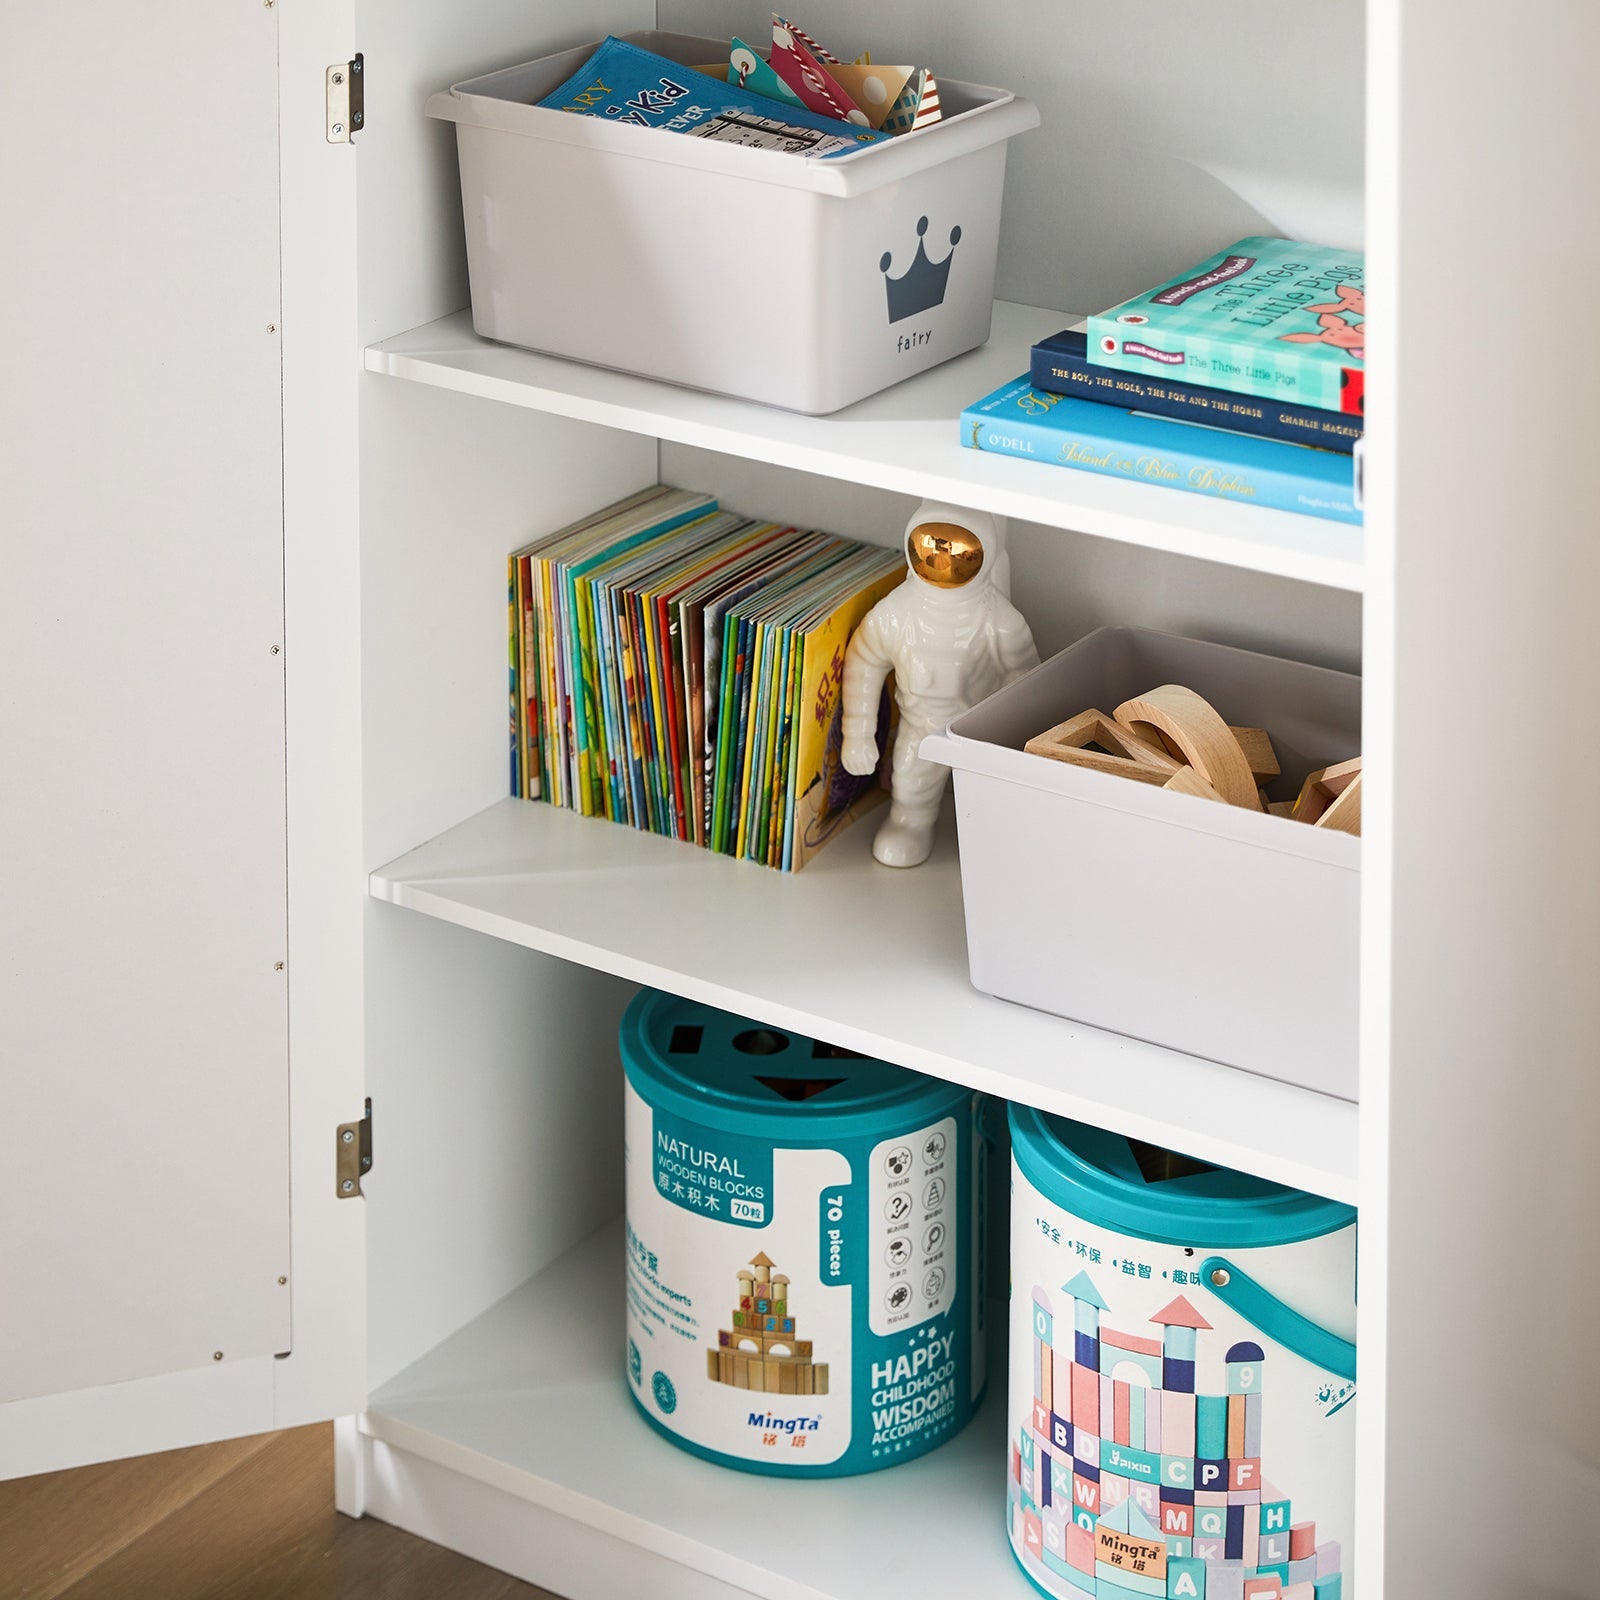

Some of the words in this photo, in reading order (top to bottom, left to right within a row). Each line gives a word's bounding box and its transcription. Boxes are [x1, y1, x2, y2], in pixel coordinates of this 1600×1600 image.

[625, 78, 690, 115] Kid
[1215, 262, 1308, 298] Three
[1231, 290, 1315, 327] Little
[1294, 265, 1363, 292] Pigs
[1212, 298, 1243, 312] The
[897, 330, 932, 353] fairy
[1188, 356, 1207, 369] The
[1211, 359, 1241, 375] Three
[1246, 366, 1271, 382] Little
[1275, 374, 1296, 386] Pigs
[1051, 368, 1069, 379] THE
[1072, 372, 1093, 386] BOY,
[1096, 377, 1113, 388] THE
[1116, 381, 1144, 396] MOLE,
[1147, 387, 1165, 398] THE
[1168, 391, 1186, 402] FOX
[1189, 396, 1208, 407] AND
[1211, 400, 1229, 412] THE
[1232, 404, 1263, 418] HORSE
[1279, 414, 1319, 429] CHARLIE
[988, 434, 1035, 453] O'DELL
[1056, 441, 1119, 468] Island
[1135, 454, 1180, 480] Blue
[1188, 465, 1256, 498] Dolphins
[657, 1130, 745, 1178] NATURAL
[657, 1153, 707, 1186] WOODEN
[709, 1176, 765, 1199] BLOCKS
[657, 1171, 720, 1212] 原木积木
[827, 1195, 843, 1222] 70
[827, 1229, 844, 1277] pieces
[1041, 1219, 1061, 1245] 安全
[1075, 1241, 1101, 1265] 环保
[1121, 1259, 1152, 1280] 益智
[1172, 1270, 1201, 1286] 趣味
[661, 1285, 692, 1307] experts
[872, 1330, 954, 1389] HAPPY
[1239, 1366, 1254, 1387] 9
[871, 1360, 955, 1407] CHILDHOOD
[872, 1378, 955, 1431] WISDOM
[747, 1412, 820, 1434] MingTa
[872, 1401, 955, 1445] ACCOMPANIED
[1034, 1404, 1046, 1429] T
[1054, 1421, 1067, 1447] B
[1079, 1435, 1095, 1459] D
[1054, 1466, 1068, 1489] X
[1075, 1480, 1096, 1507] W
[1106, 1479, 1121, 1500] N
[1168, 1461, 1187, 1482] C
[1202, 1464, 1220, 1486] P
[1236, 1464, 1254, 1486] F
[1165, 1509, 1187, 1532] M
[1201, 1513, 1221, 1534] Q
[1266, 1507, 1284, 1530] H
[1101, 1533, 1158, 1560] MingTa
[1268, 1538, 1281, 1559] L
[1174, 1572, 1197, 1597] A
